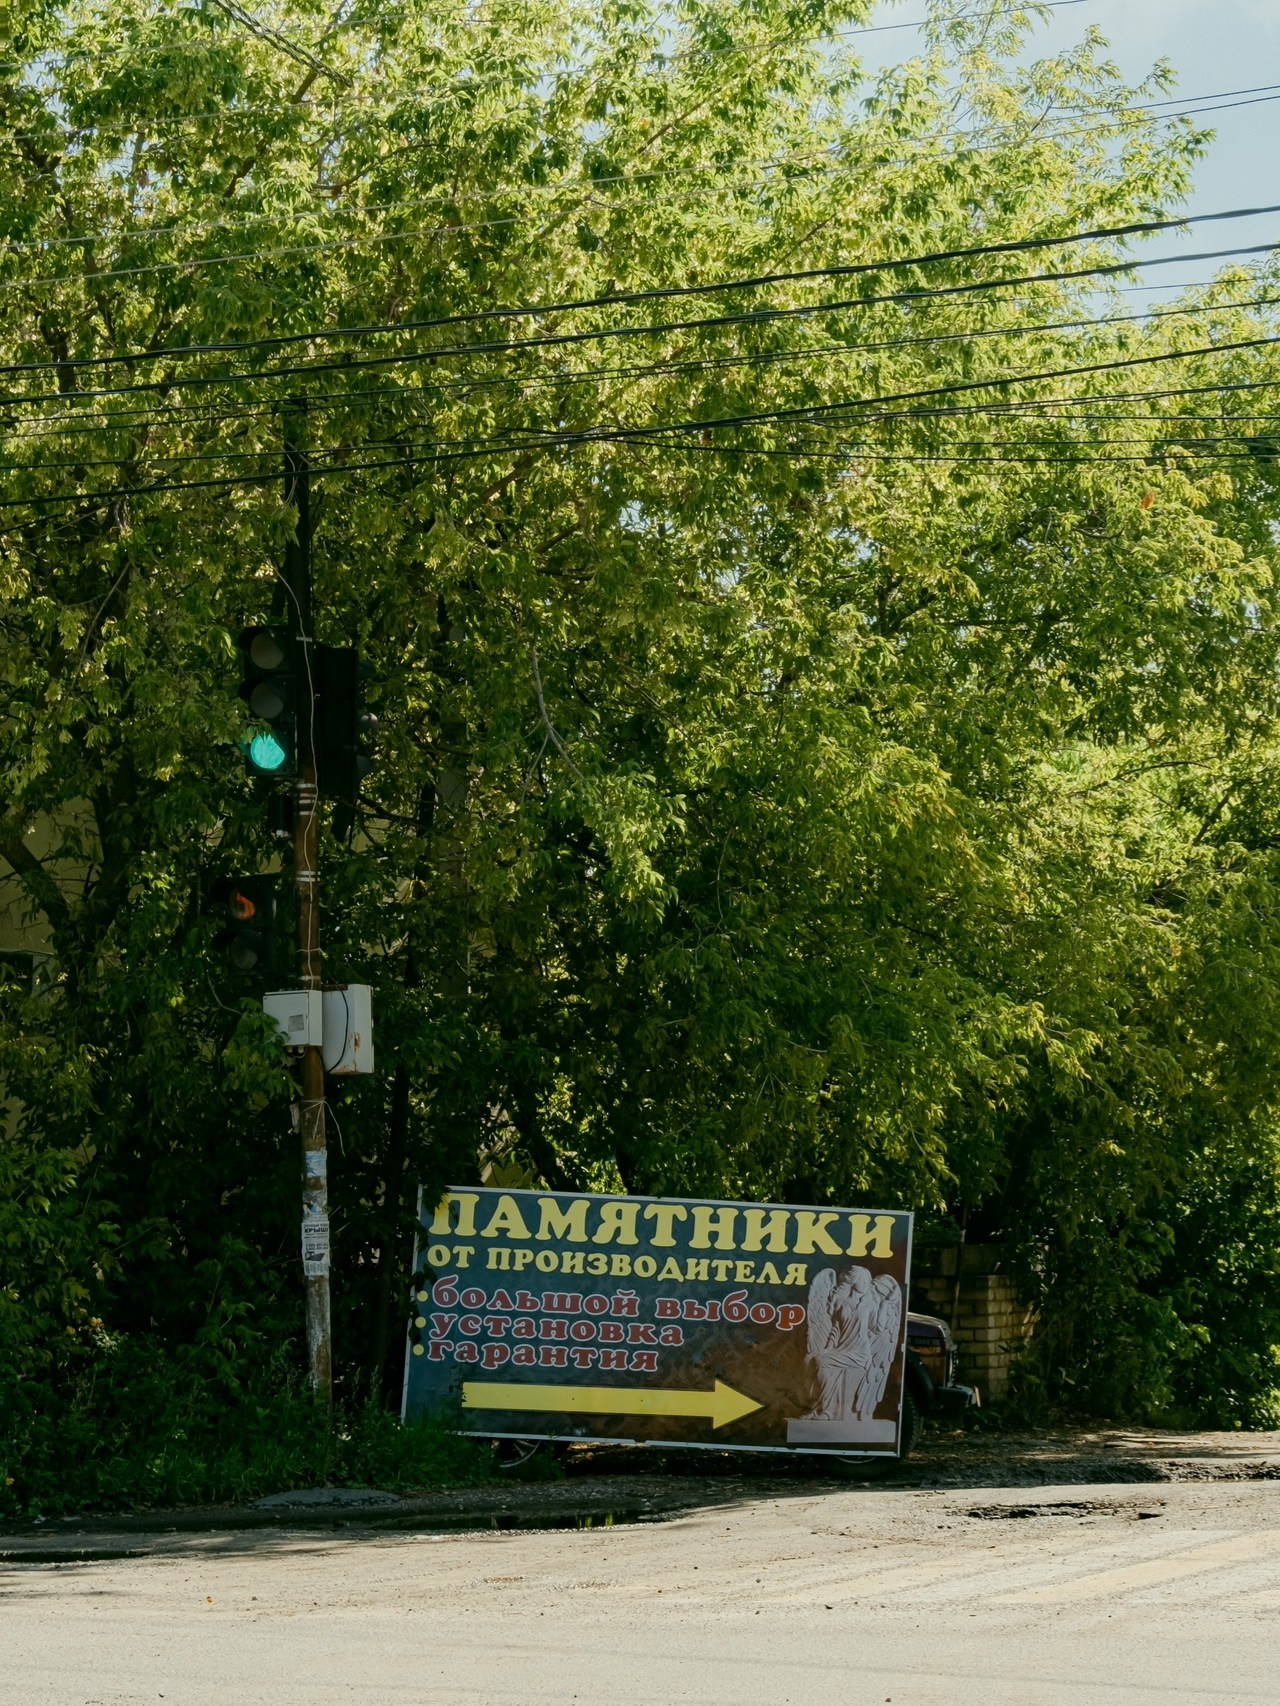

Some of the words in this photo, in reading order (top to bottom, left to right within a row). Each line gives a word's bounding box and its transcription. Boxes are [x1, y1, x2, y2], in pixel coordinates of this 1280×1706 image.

[429, 1193, 896, 1258] ПАМЯТНИКИ
[427, 1244, 475, 1268] ОТ
[486, 1247, 808, 1286] ПРОИЗВОДИТЕЛЯ
[432, 1274, 639, 1317] большой
[655, 1290, 806, 1331] выбор
[429, 1313, 684, 1347] установка
[427, 1340, 658, 1372] гарантия
